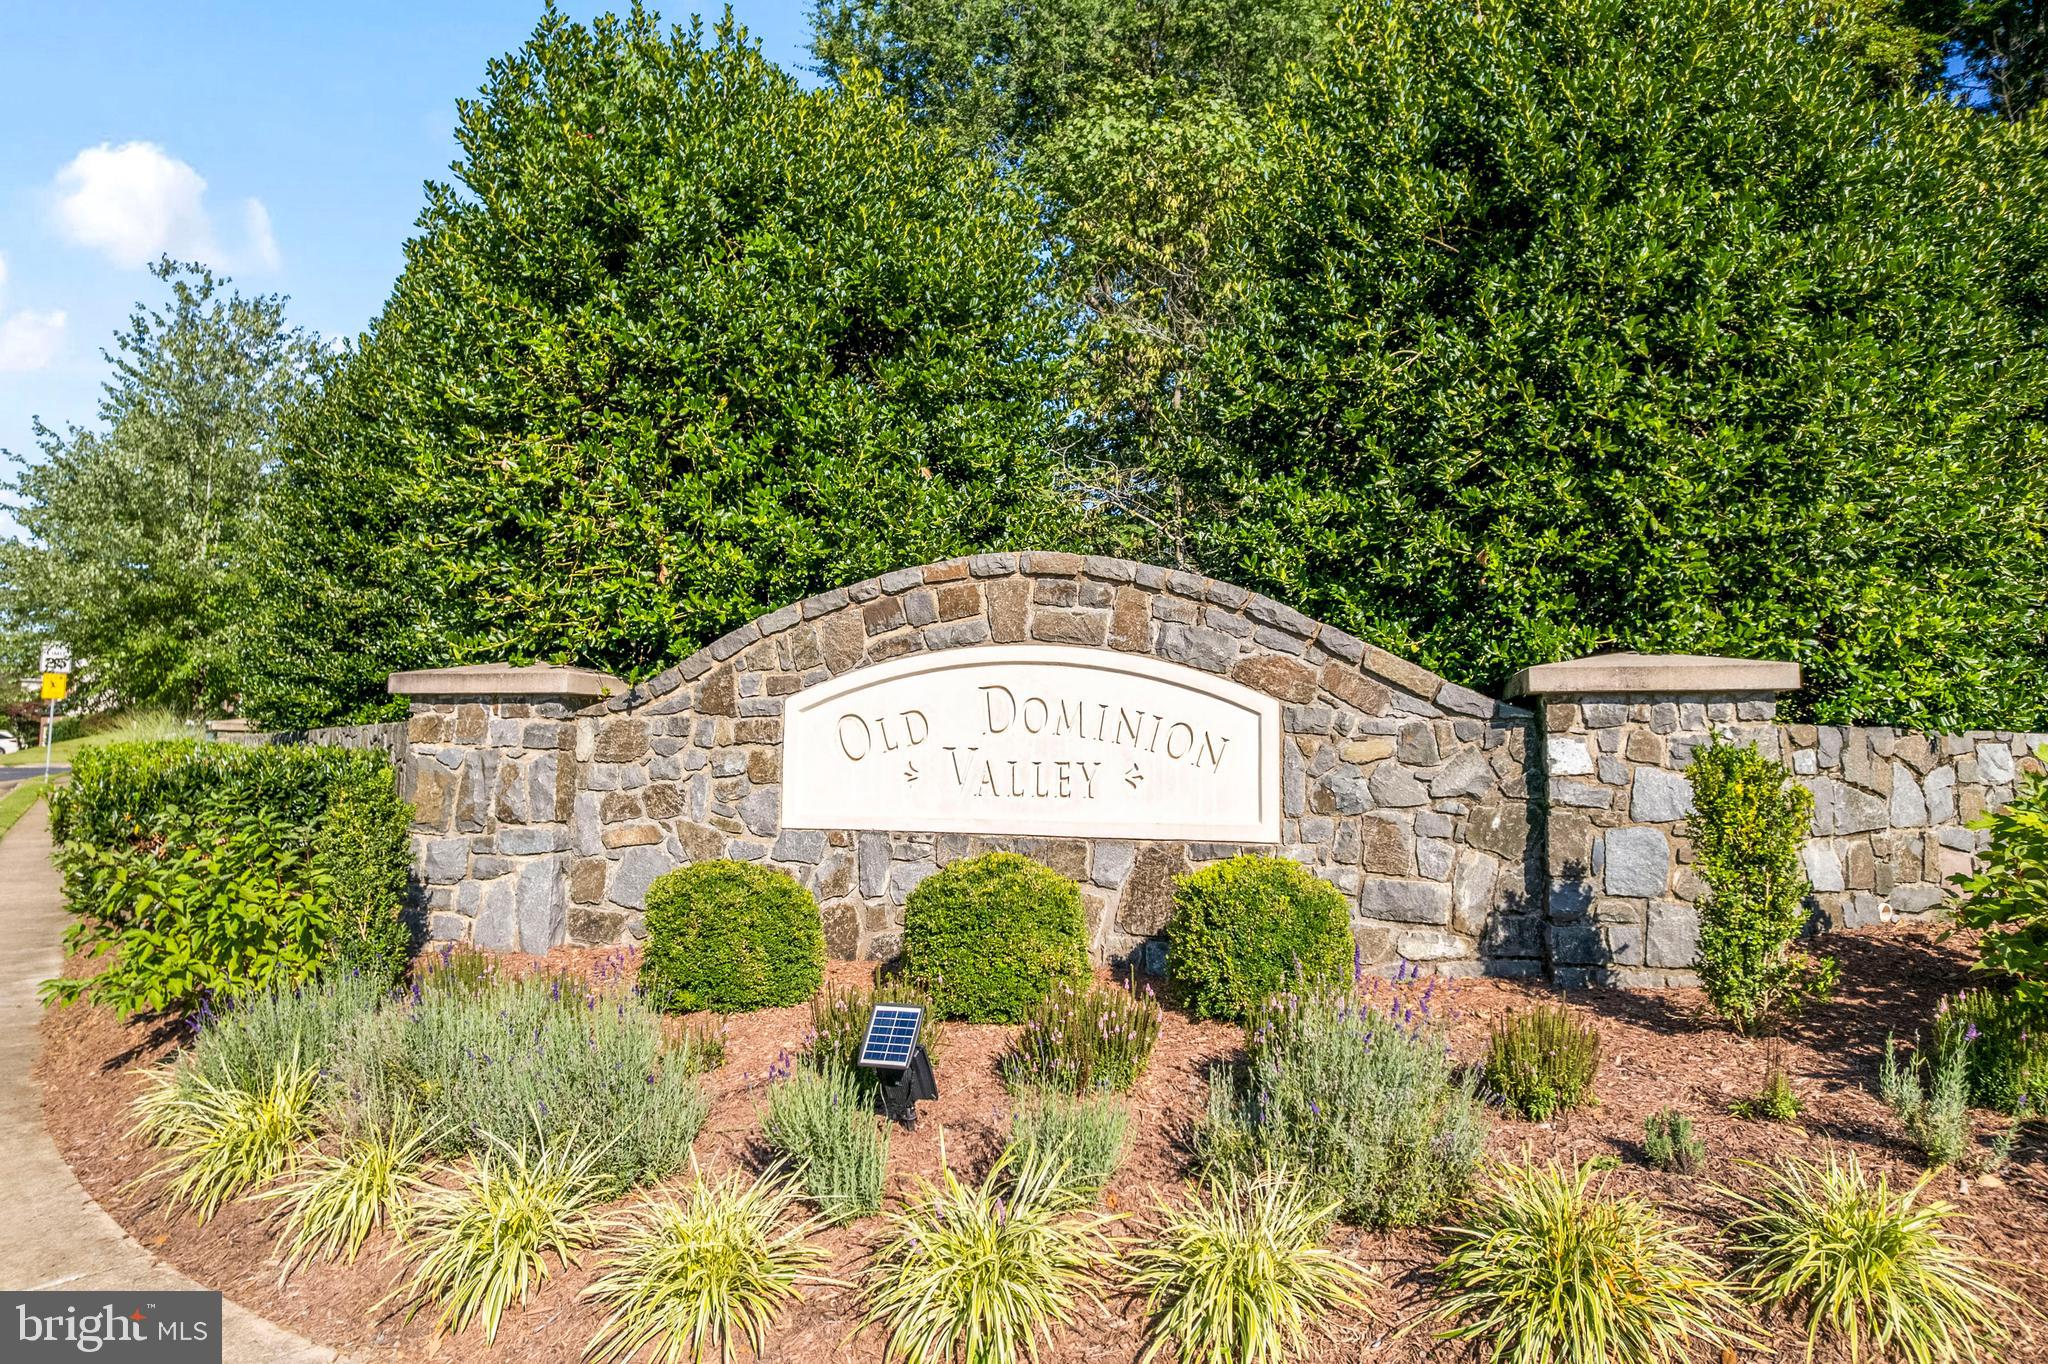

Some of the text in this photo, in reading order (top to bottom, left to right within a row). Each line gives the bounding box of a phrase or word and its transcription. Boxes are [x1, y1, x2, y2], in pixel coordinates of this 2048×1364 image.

[838, 685, 1230, 774] OLD DOMINION
[942, 746, 1102, 799] VALLEY
